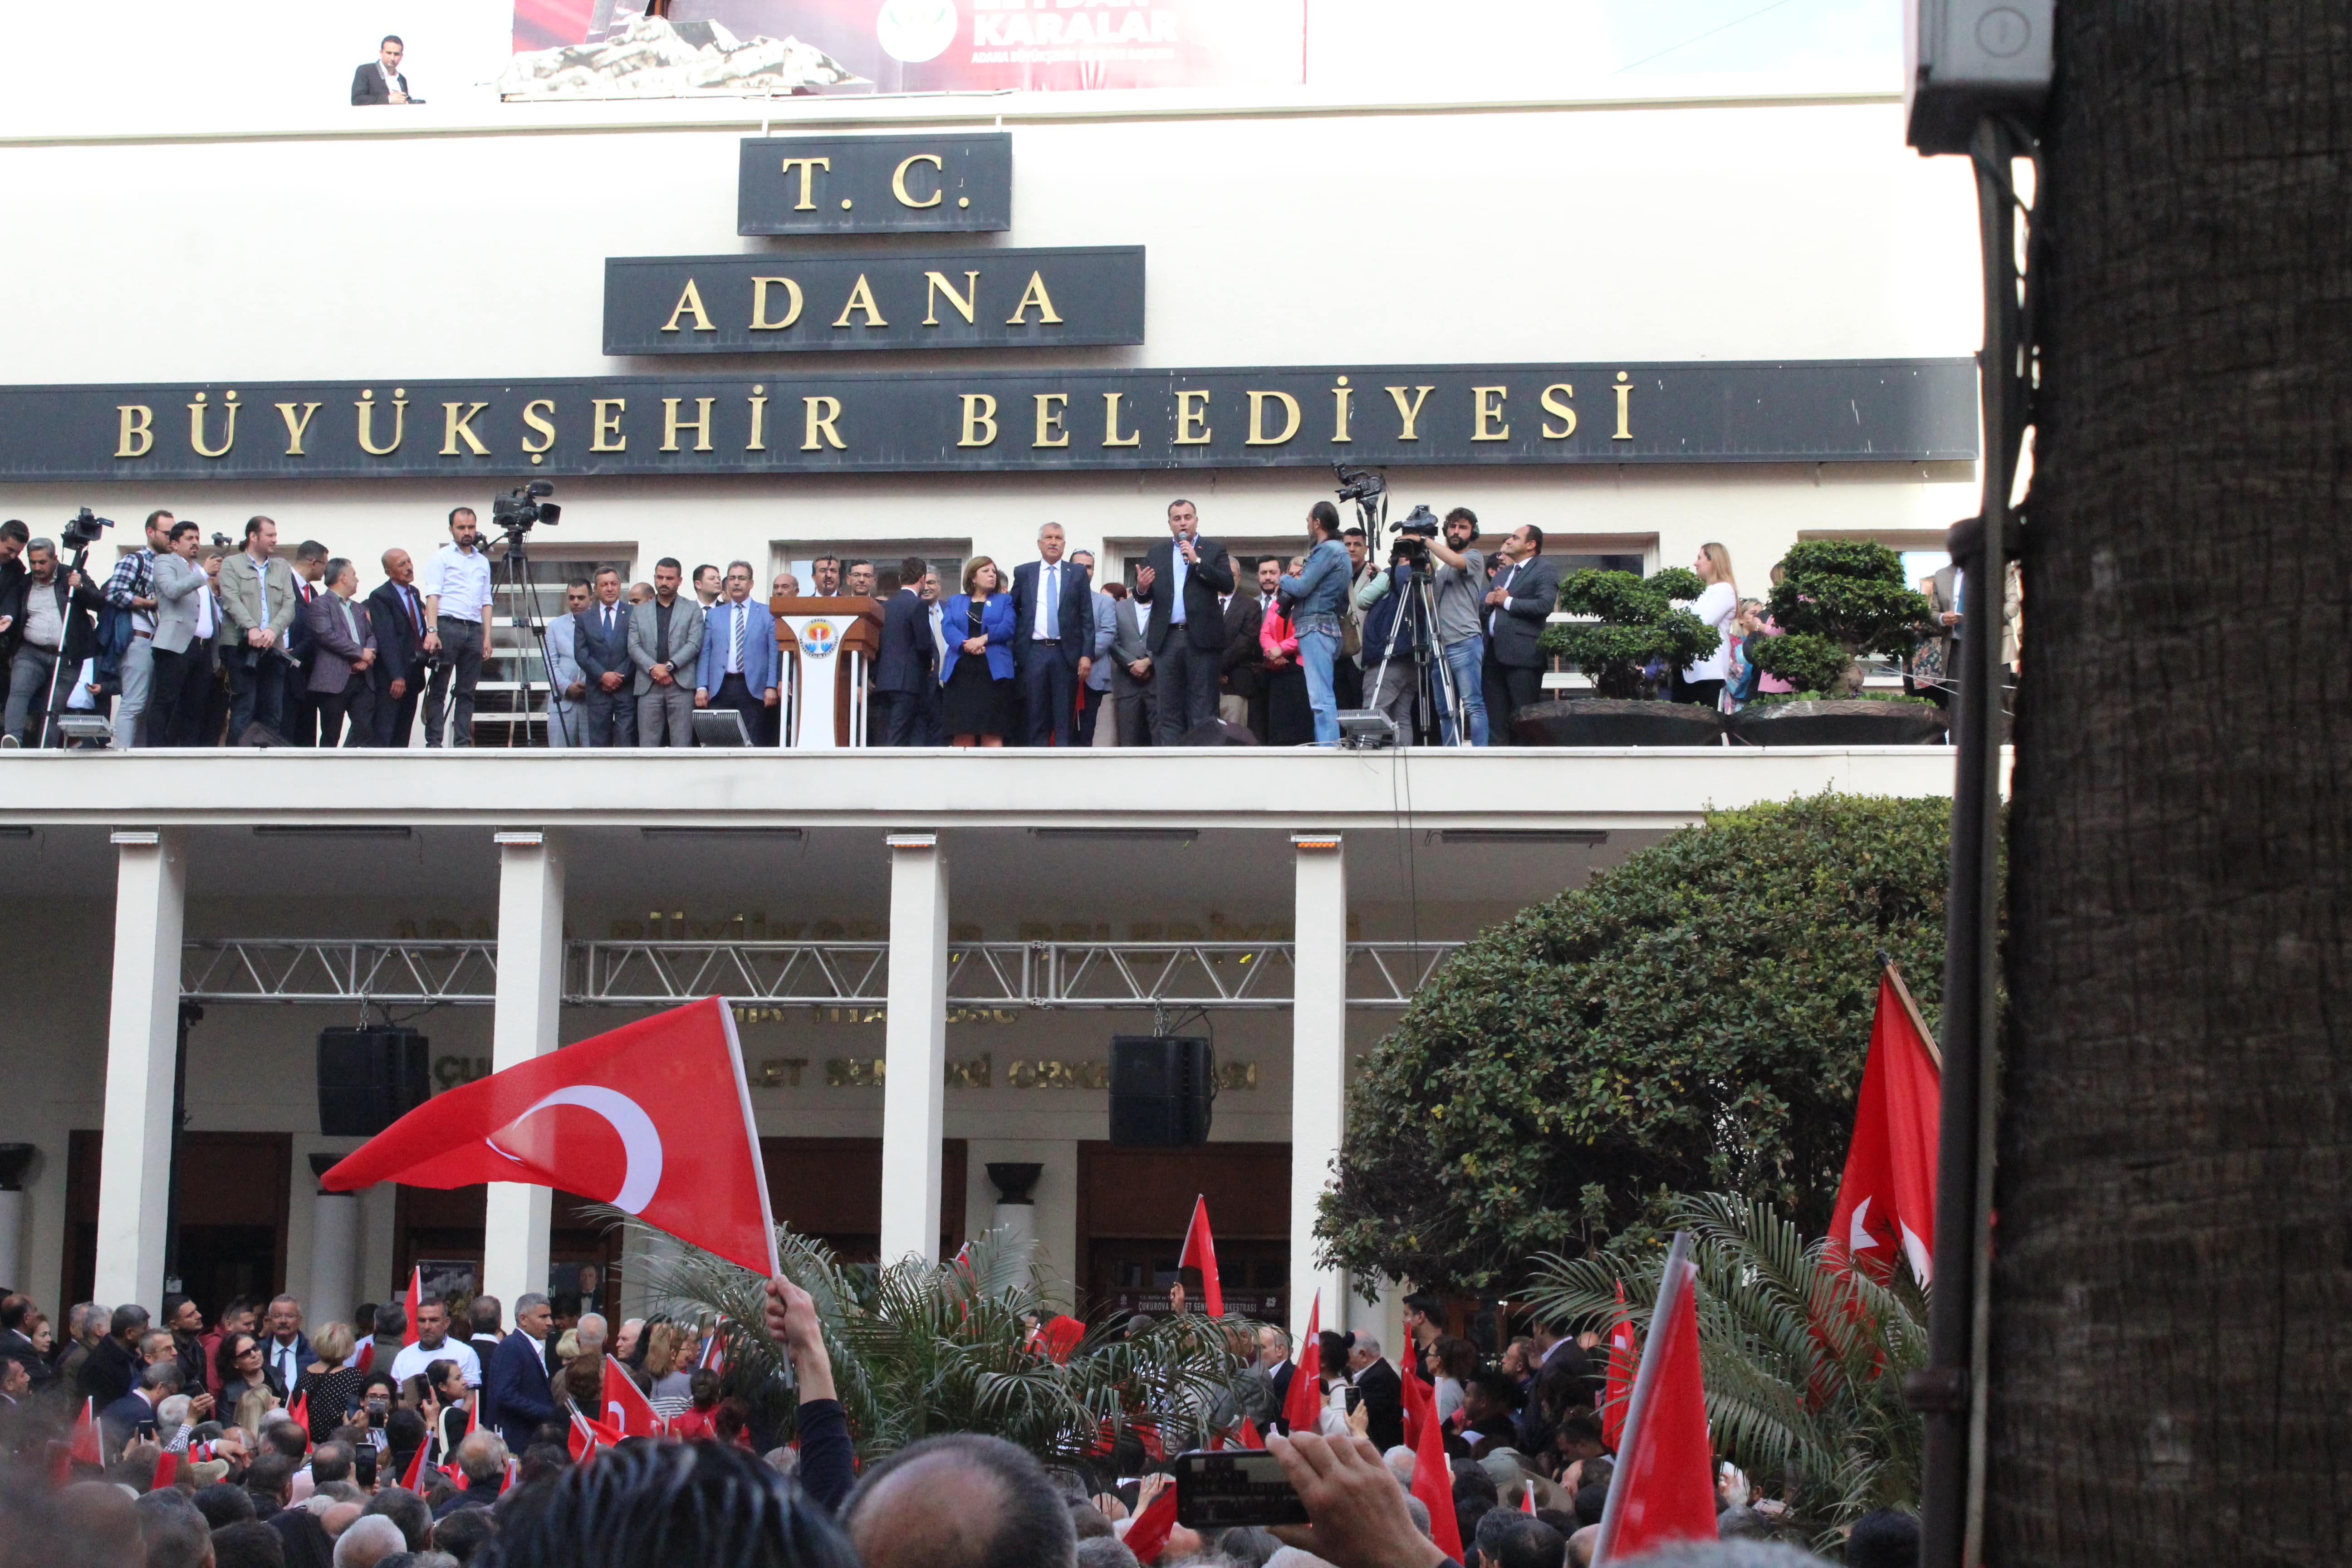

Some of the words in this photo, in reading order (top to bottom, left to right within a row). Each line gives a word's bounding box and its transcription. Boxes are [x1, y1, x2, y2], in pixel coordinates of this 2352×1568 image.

[974, 10, 1178, 46] KARALAR
[971, 51, 1009, 63] ADANA
[661, 270, 1063, 331] ADANA
[113, 385, 847, 465] BÜYÜKŞEHİR
[957, 370, 1633, 447] BELEDİYESİ
[1139, 1302, 1169, 1313] ÇUKUROVA
